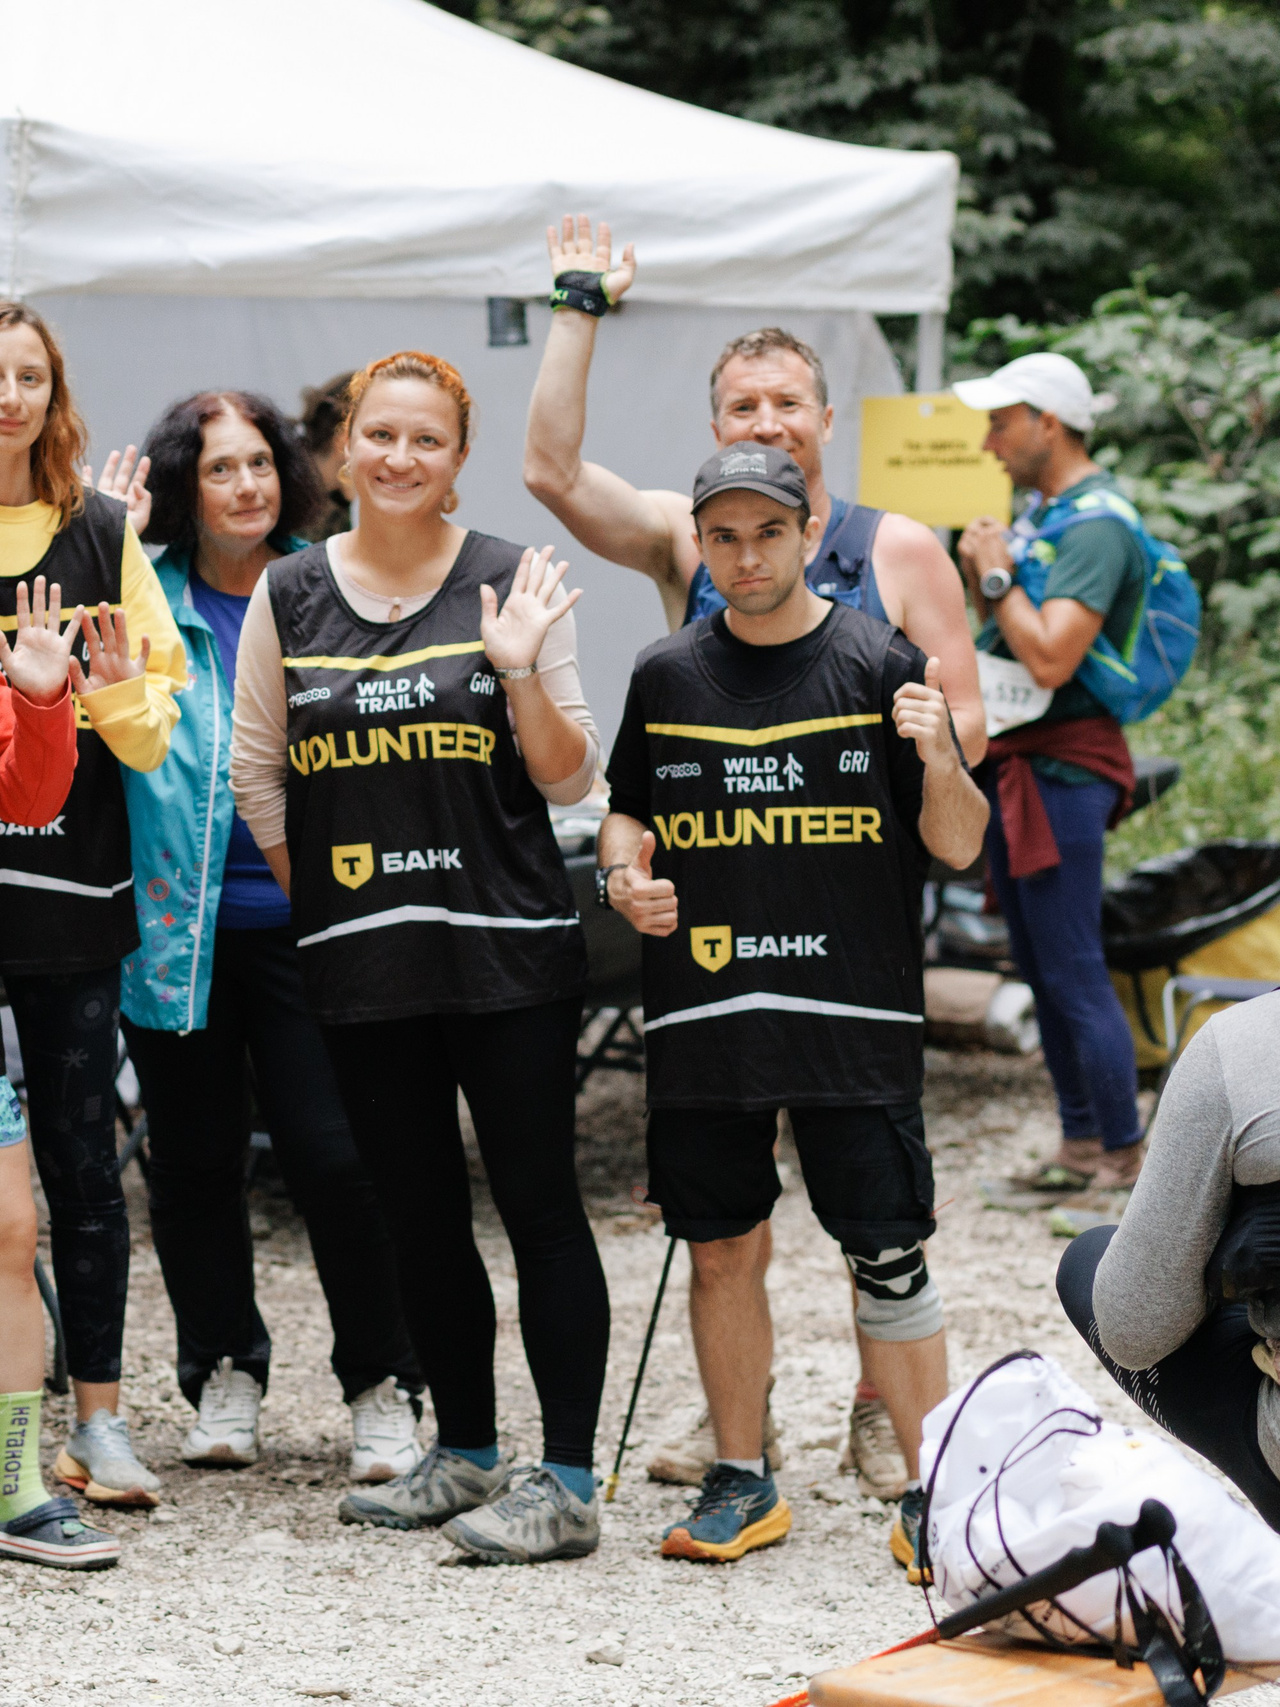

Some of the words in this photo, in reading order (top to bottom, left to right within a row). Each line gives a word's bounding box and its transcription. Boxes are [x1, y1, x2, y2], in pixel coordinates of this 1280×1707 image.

[356, 678, 411, 697] WILD
[355, 694, 416, 714] TRAIL
[288, 722, 496, 776] VOLUNTEER
[724, 757, 778, 774] WILD
[723, 775, 784, 793] TRAIL
[653, 806, 883, 851] VOLUNTEER
[381, 848, 462, 874] БАНК
[736, 934, 827, 959] БАНК
